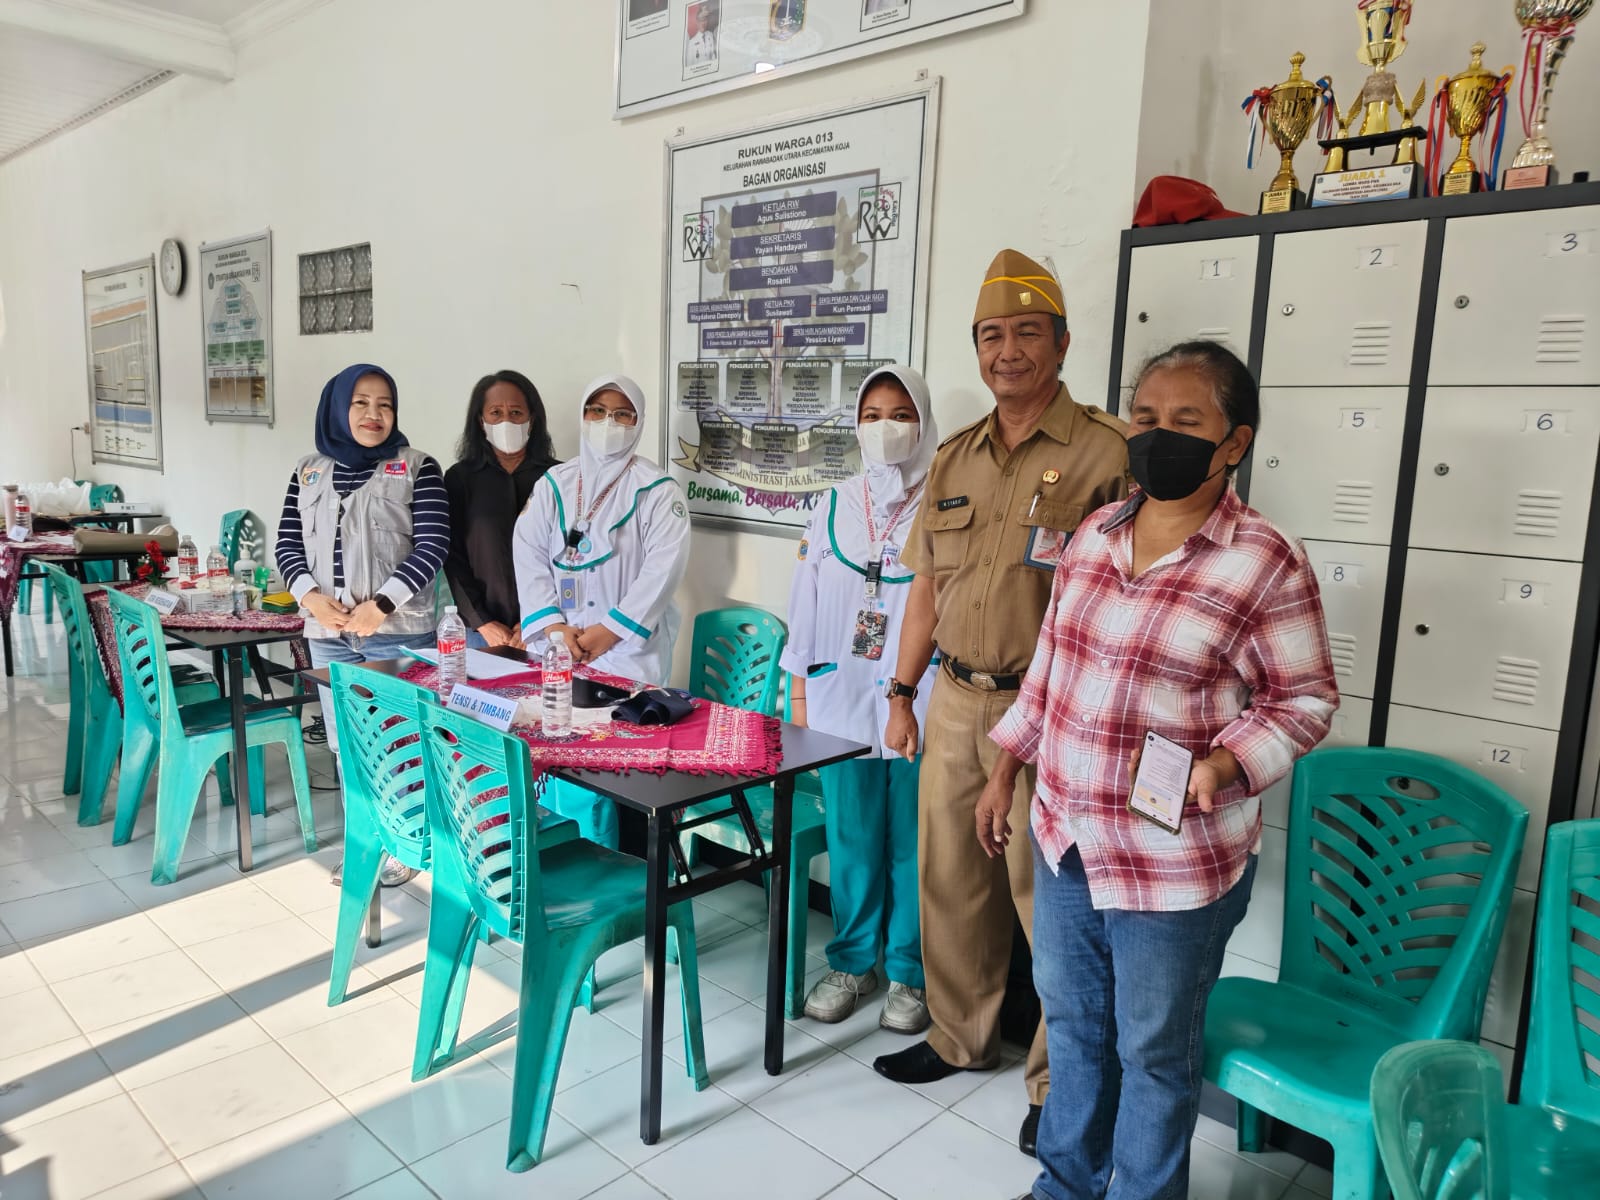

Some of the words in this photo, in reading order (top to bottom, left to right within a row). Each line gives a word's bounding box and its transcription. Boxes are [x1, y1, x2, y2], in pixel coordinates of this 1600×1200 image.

[738, 143, 772, 160] RUKUN
[774, 136, 813, 152] WARGA
[815, 131, 834, 144] 013
[723, 160, 752, 172] KELURAHAN
[752, 154, 784, 166] RAWABADAK
[784, 151, 801, 161] UTARA
[801, 145, 834, 157] KECAMATAN
[834, 141, 850, 151] KOJA
[743, 171, 772, 188] BAGAN
[773, 161, 826, 182] ORGANISASI
[762, 201, 786, 214] KETUA
[787, 199, 800, 210] RW
[757, 215, 774, 225] Agus
[760, 232, 802, 245] SEKRETARIS
[1561, 233, 1579, 252] 3
[754, 245, 773, 255] Yayan
[774, 242, 808, 253] Handayani
[1369, 248, 1383, 266] 2
[761, 264, 798, 276] BENDAHARA
[1213, 260, 1221, 277] 1
[767, 276, 791, 285] Rosanti
[846, 304, 872, 312] Permadi
[1351, 411, 1365, 428] 5
[1537, 413, 1554, 430] 6
[687, 481, 743, 505] Bersama,
[745, 486, 800, 512] Bersatu,
[1333, 566, 1345, 582] 8
[1520, 584, 1533, 599] 9
[451, 692, 472, 708] TENSI
[471, 698, 478, 710] &
[478, 701, 512, 722] TIMBANG
[1492, 748, 1511, 764] 12
